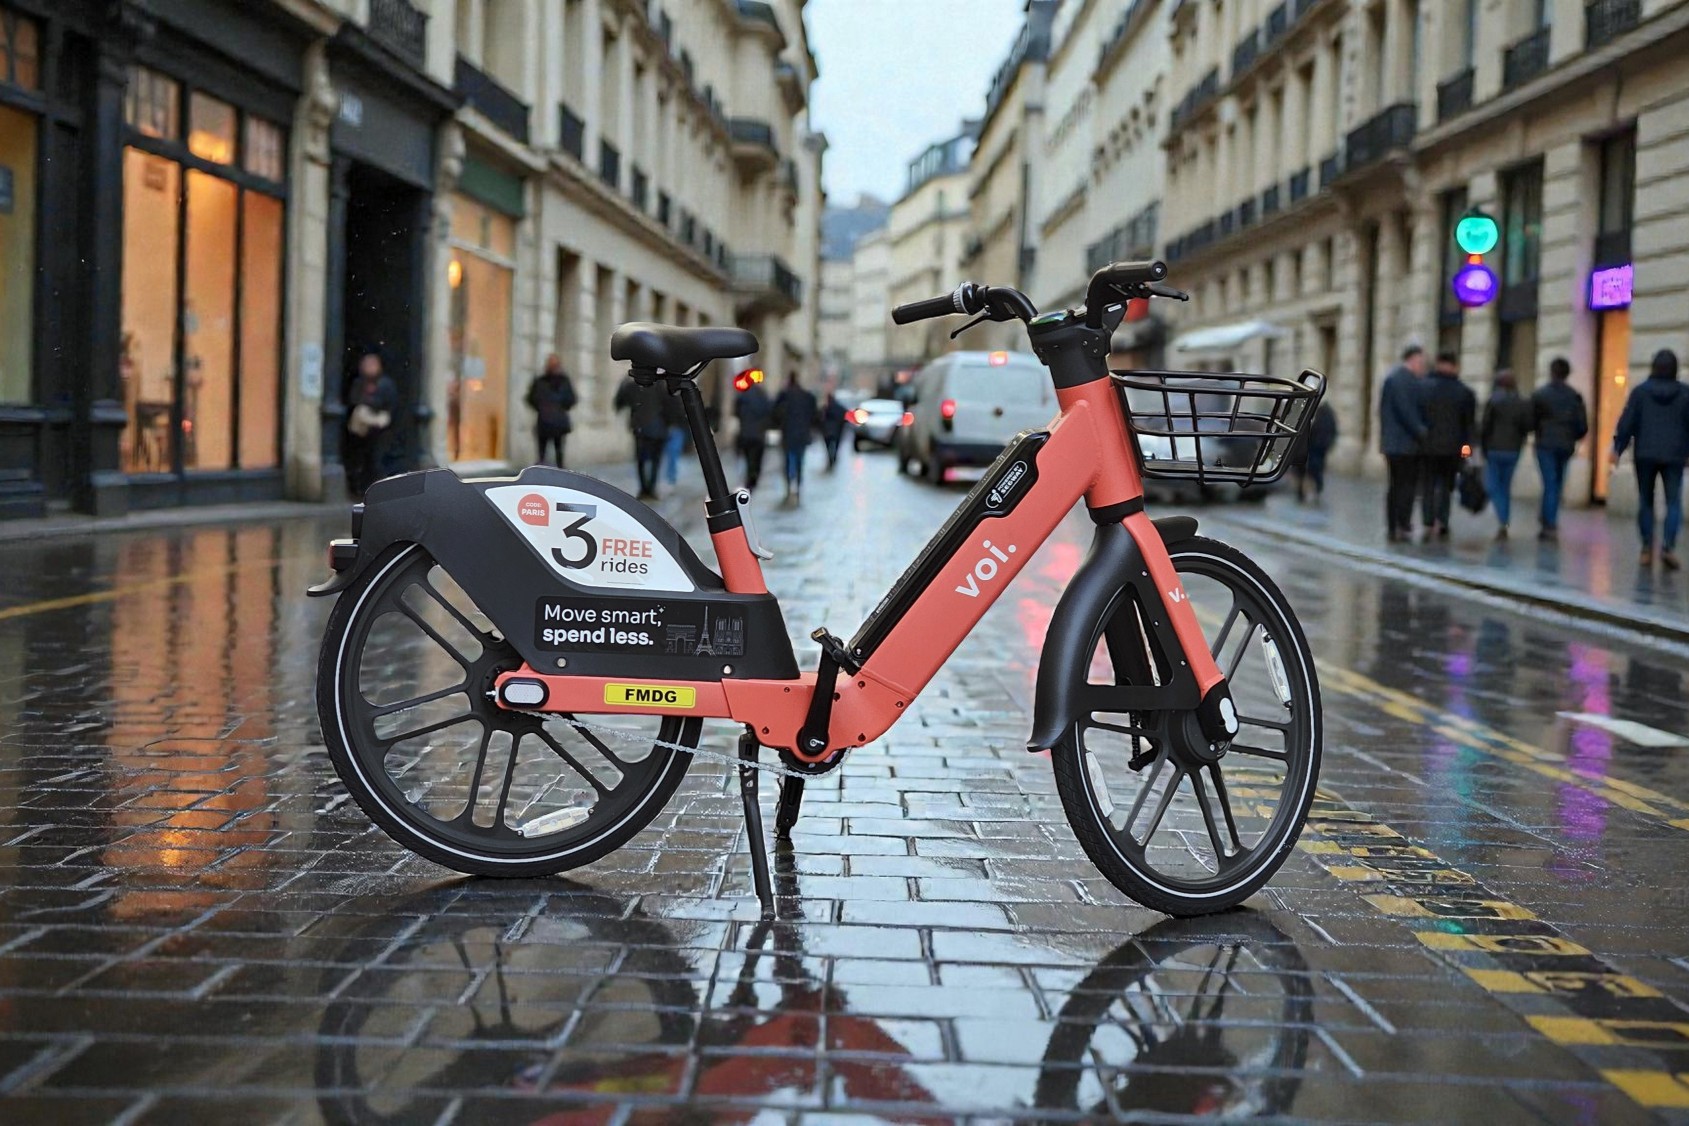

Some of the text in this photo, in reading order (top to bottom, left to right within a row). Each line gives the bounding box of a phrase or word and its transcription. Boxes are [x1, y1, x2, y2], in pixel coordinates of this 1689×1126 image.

[1000, 467, 1023, 494] SEGWAY
[521, 508, 546, 516] PARIS
[551, 502, 598, 570] 3
[602, 538, 653, 558] FREE
[601, 558, 649, 575] rides
[955, 539, 1017, 597] voi.
[544, 604, 662, 627] Move smart,
[542, 627, 654, 645] spend less.
[625, 688, 677, 703] FMDG
